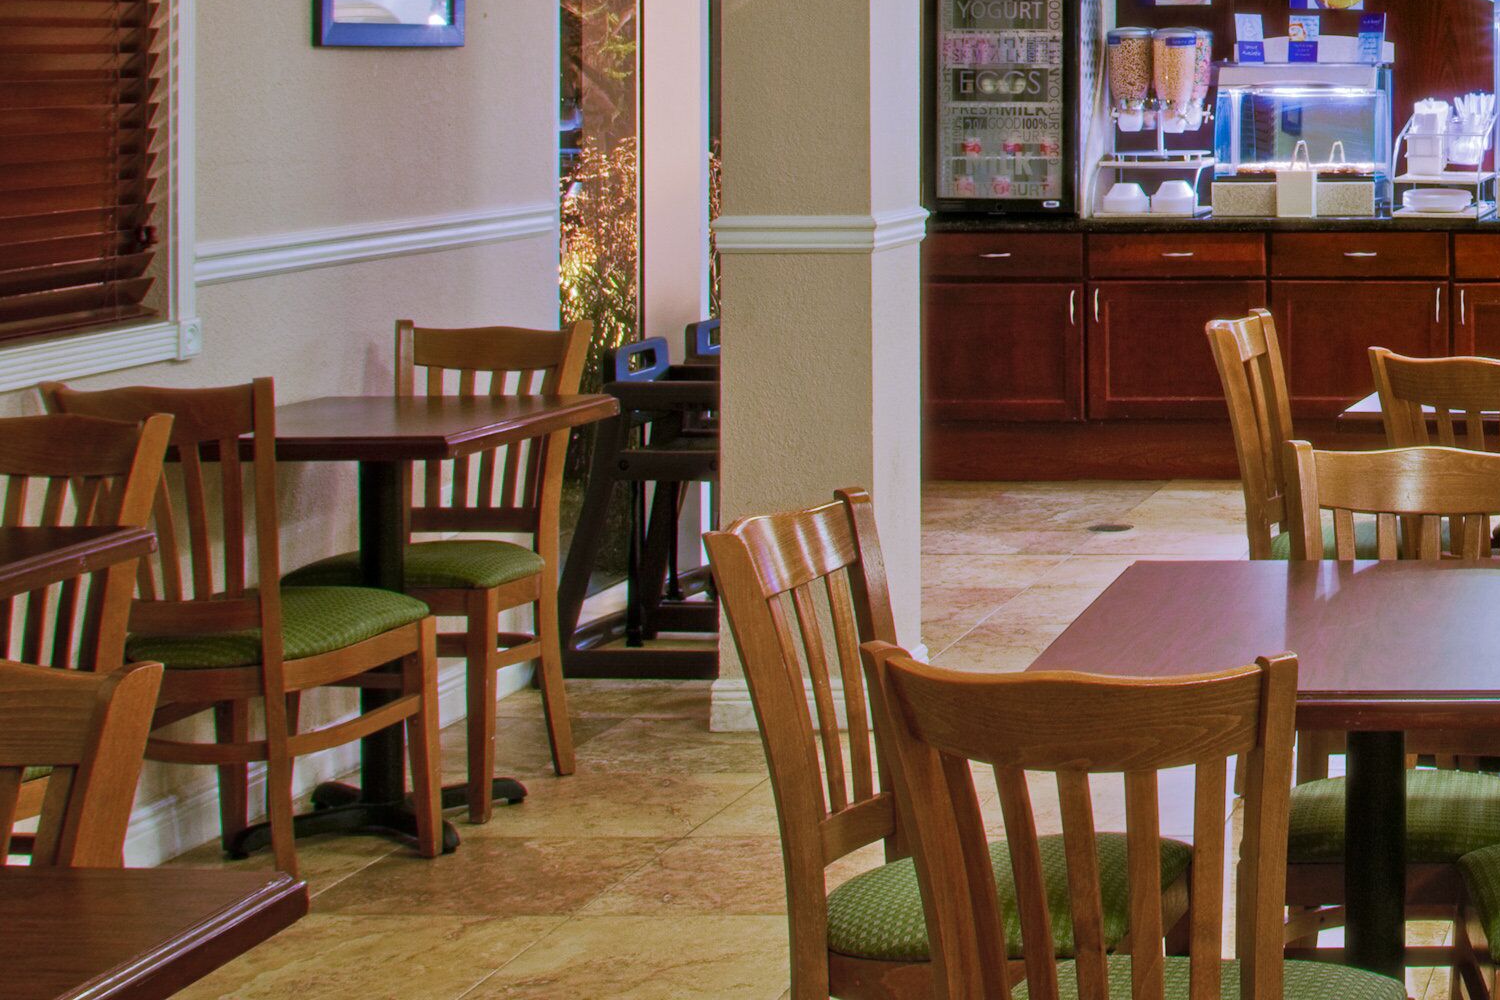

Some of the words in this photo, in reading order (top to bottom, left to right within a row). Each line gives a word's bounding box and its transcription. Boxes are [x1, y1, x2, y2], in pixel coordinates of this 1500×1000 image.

[957, 0, 1044, 20] YOGURT
[960, 70, 1041, 94] EGGS
[1022, 118, 1047, 130] 100%
